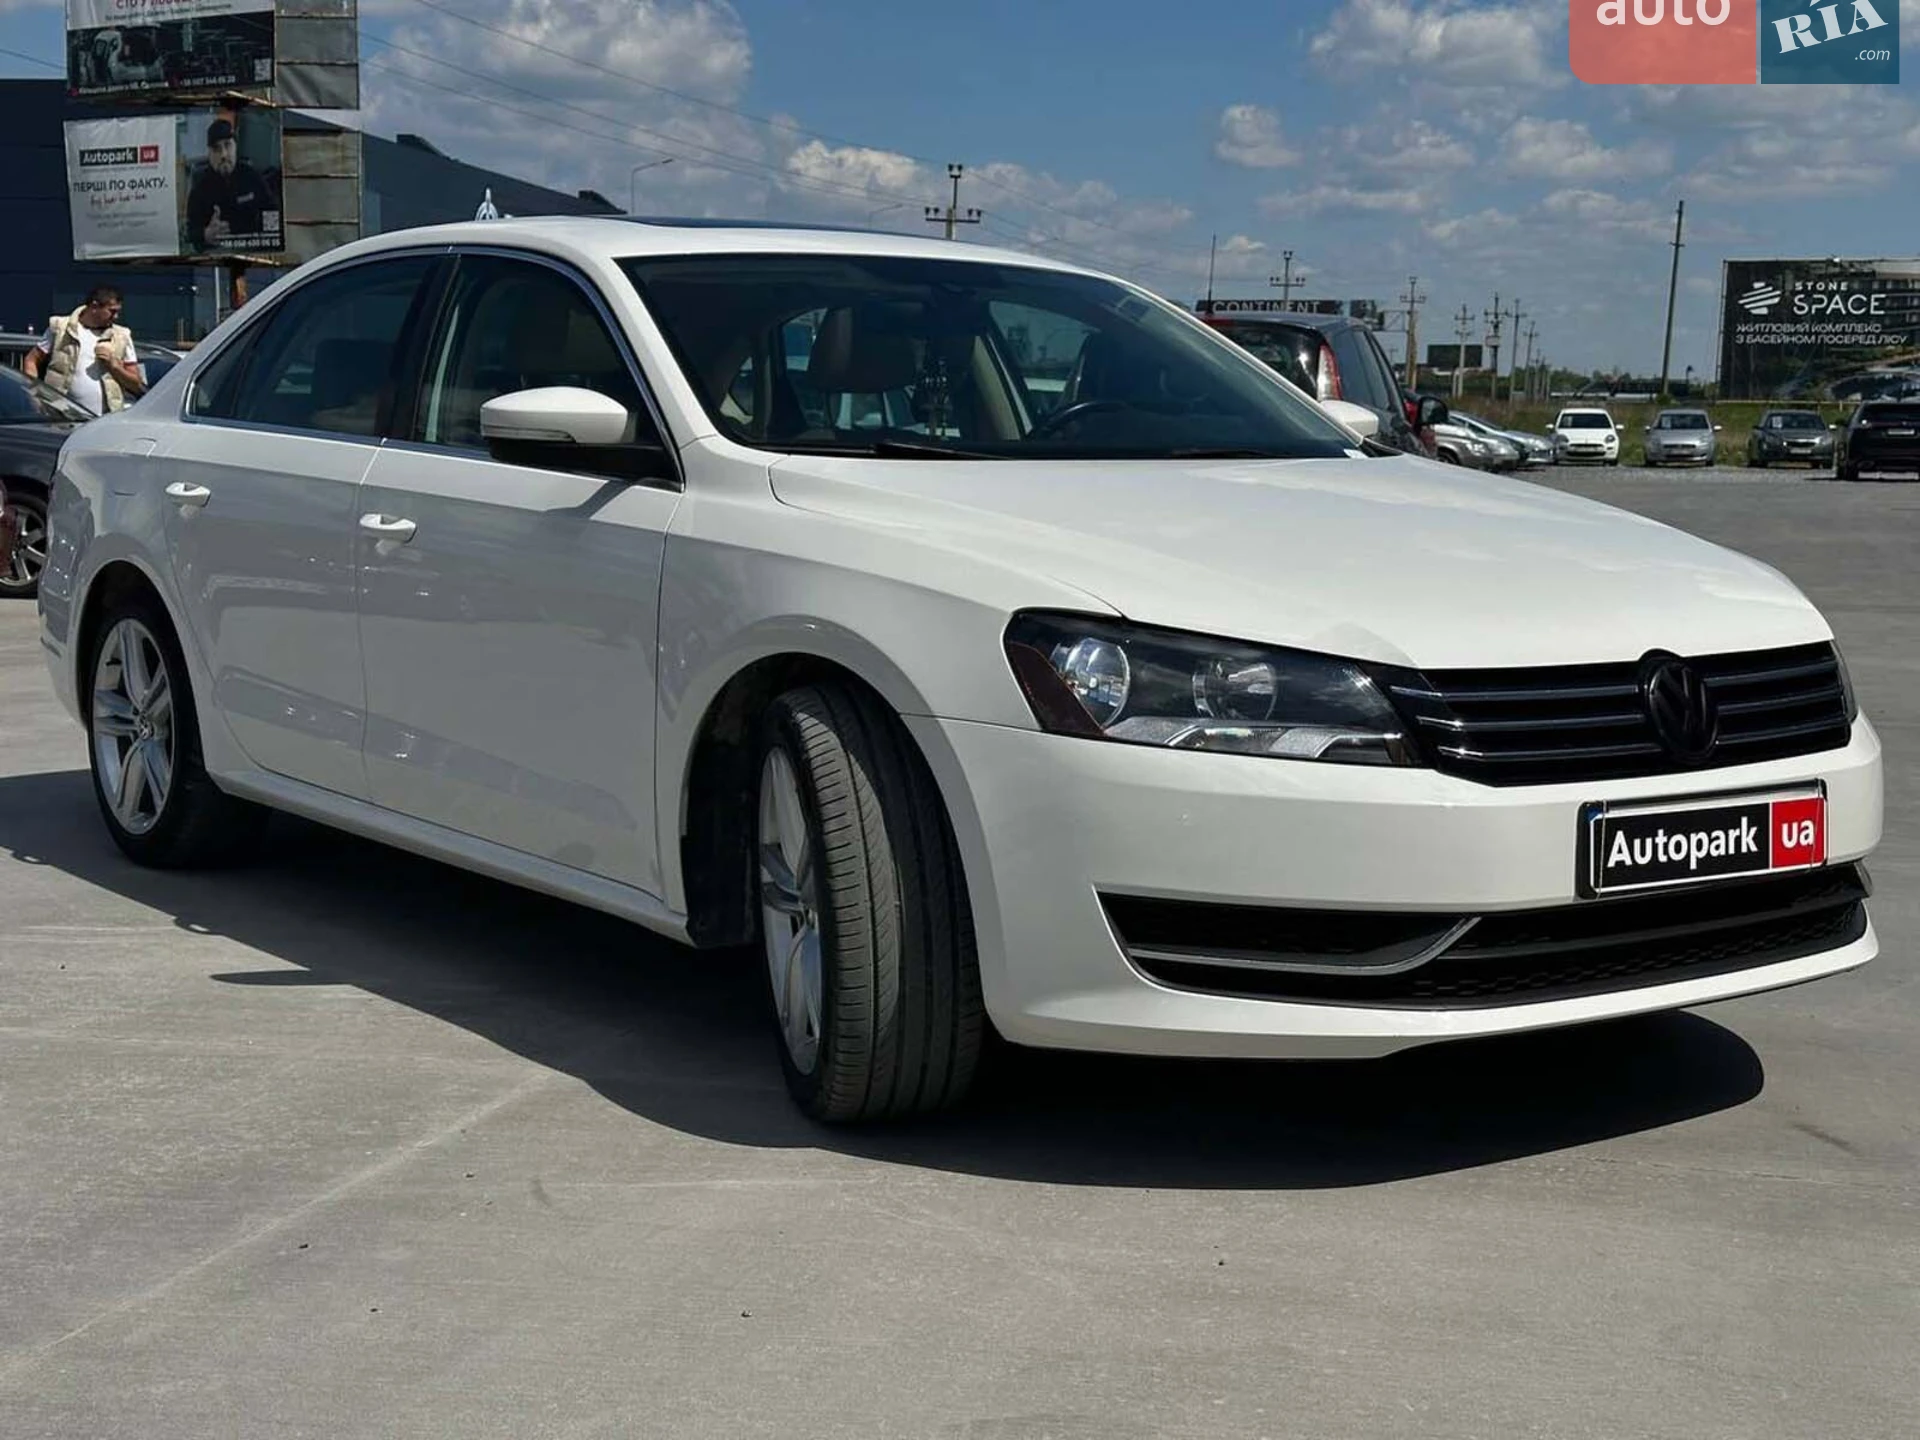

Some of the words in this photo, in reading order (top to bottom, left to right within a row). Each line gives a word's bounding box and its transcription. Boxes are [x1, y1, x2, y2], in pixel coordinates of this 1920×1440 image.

[83, 148, 134, 164] Autopark
[73, 181, 107, 193] ПЕРШІ
[109, 180, 126, 190] ПО
[1794, 281, 1849, 291] STONE
[1212, 301, 1321, 314] CONTINENT
[1793, 294, 1886, 315] SPACE
[1736, 322, 1810, 333] ЖИТЛОВИЙ
[1811, 323, 1882, 333] КОМПЛЕКС
[1745, 333, 1816, 344] БАСЕЙНОМ
[1817, 335, 1877, 345] ПОСЕРЕД
[1878, 335, 1908, 344] ЛІСУ
[1606, 816, 1759, 870] Autopark
[1781, 819, 1815, 849] ua
